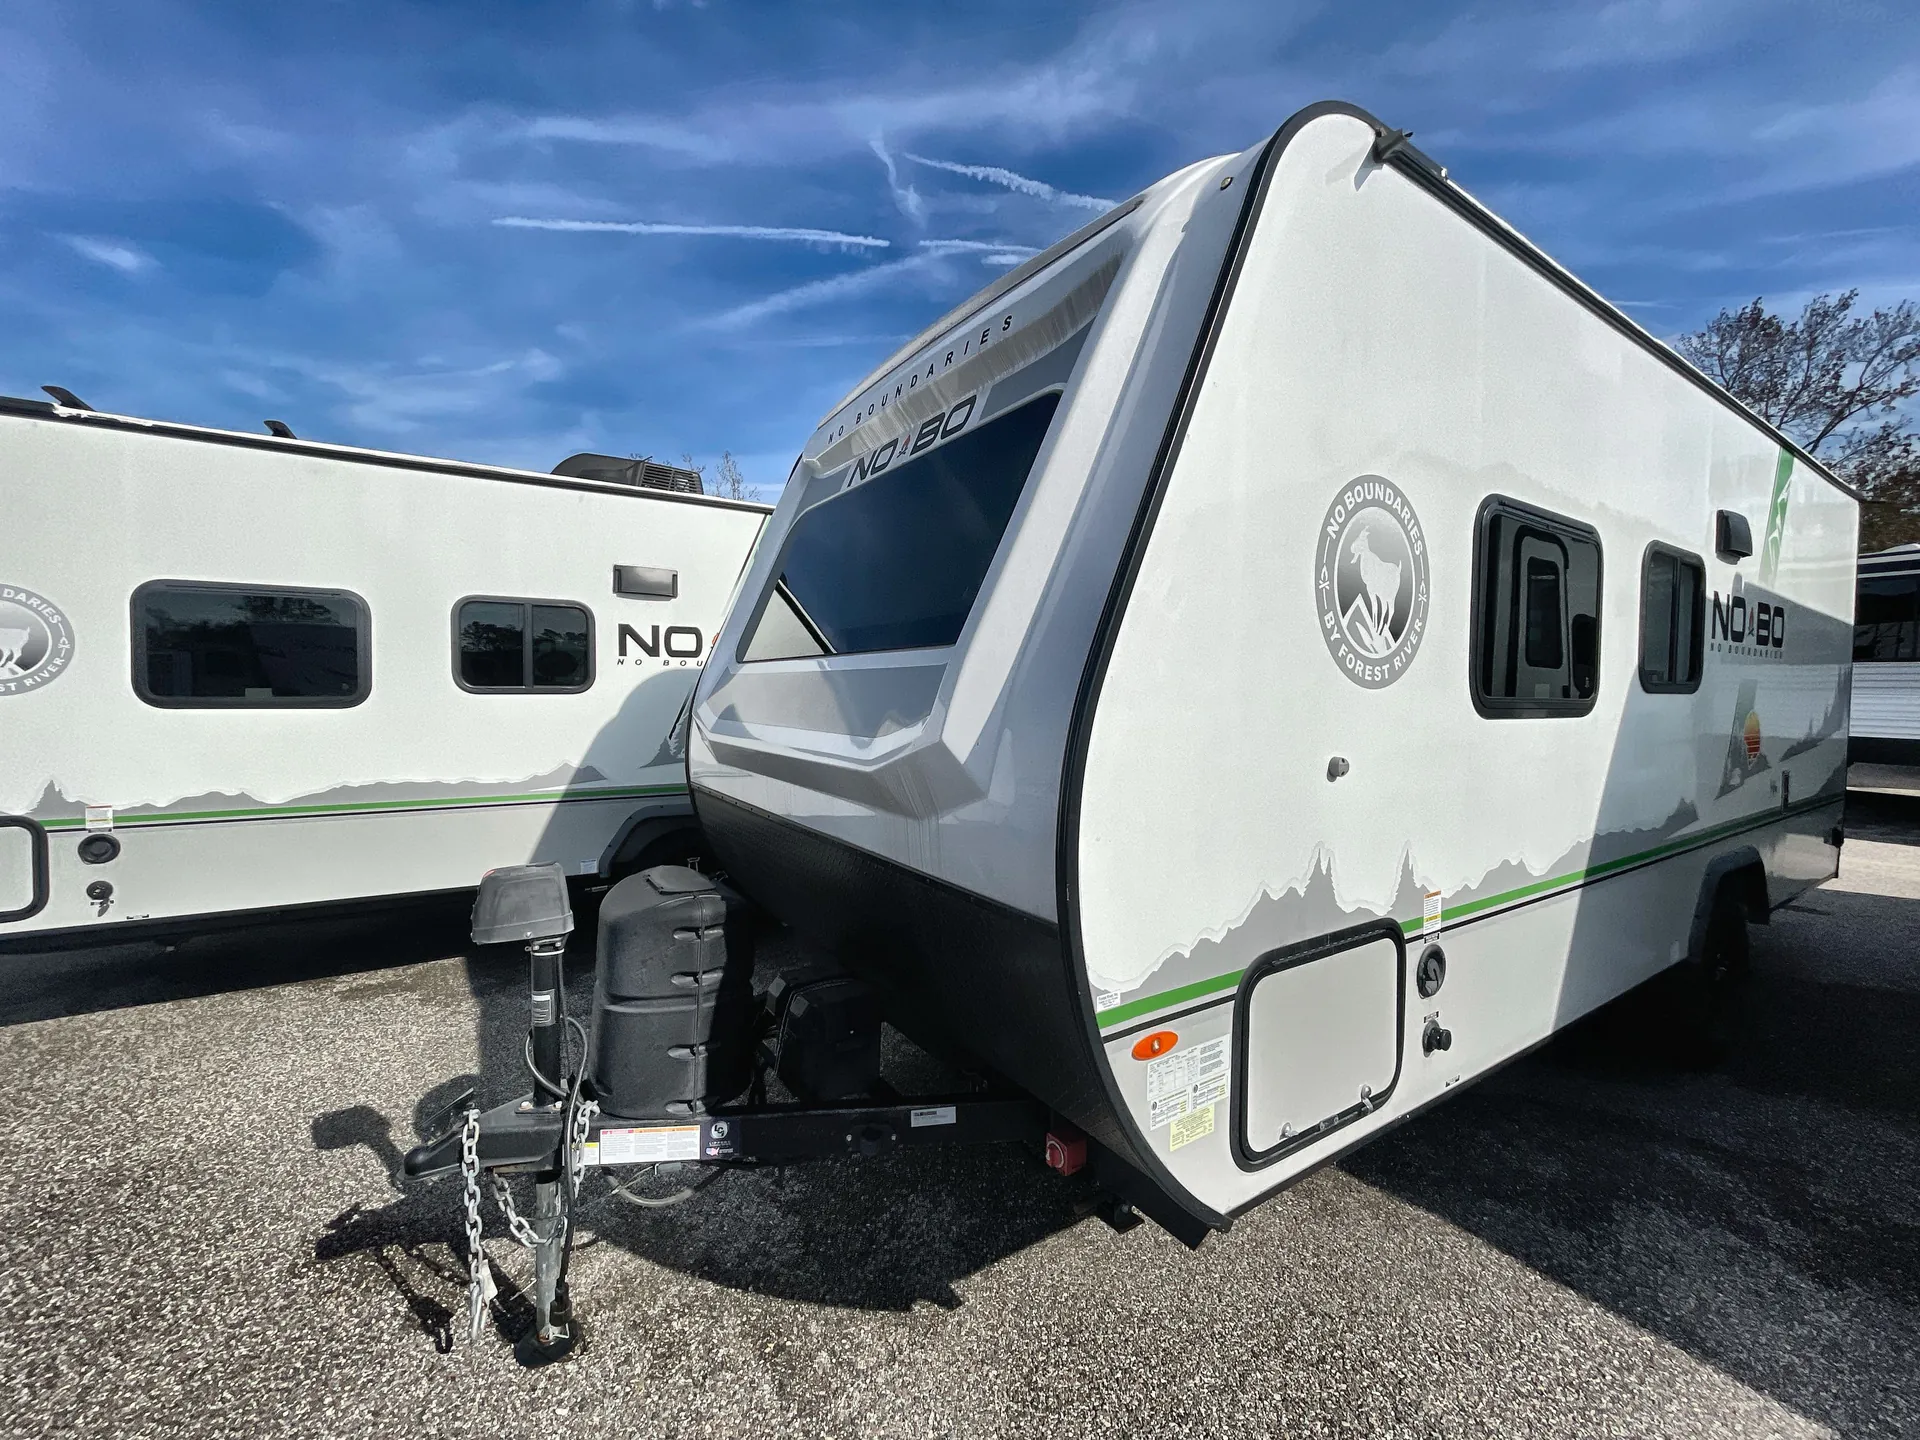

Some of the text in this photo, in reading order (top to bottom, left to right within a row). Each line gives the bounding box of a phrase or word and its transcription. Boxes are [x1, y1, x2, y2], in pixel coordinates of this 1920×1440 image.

[828, 315, 1013, 445] NO BOUNDARIES
[1327, 482, 1423, 556] NO BOUNDARIES
[23, 657, 65, 686] RIVER
[617, 658, 643, 666] NO
[1324, 610, 1423, 682] BY FOREST RIVER
